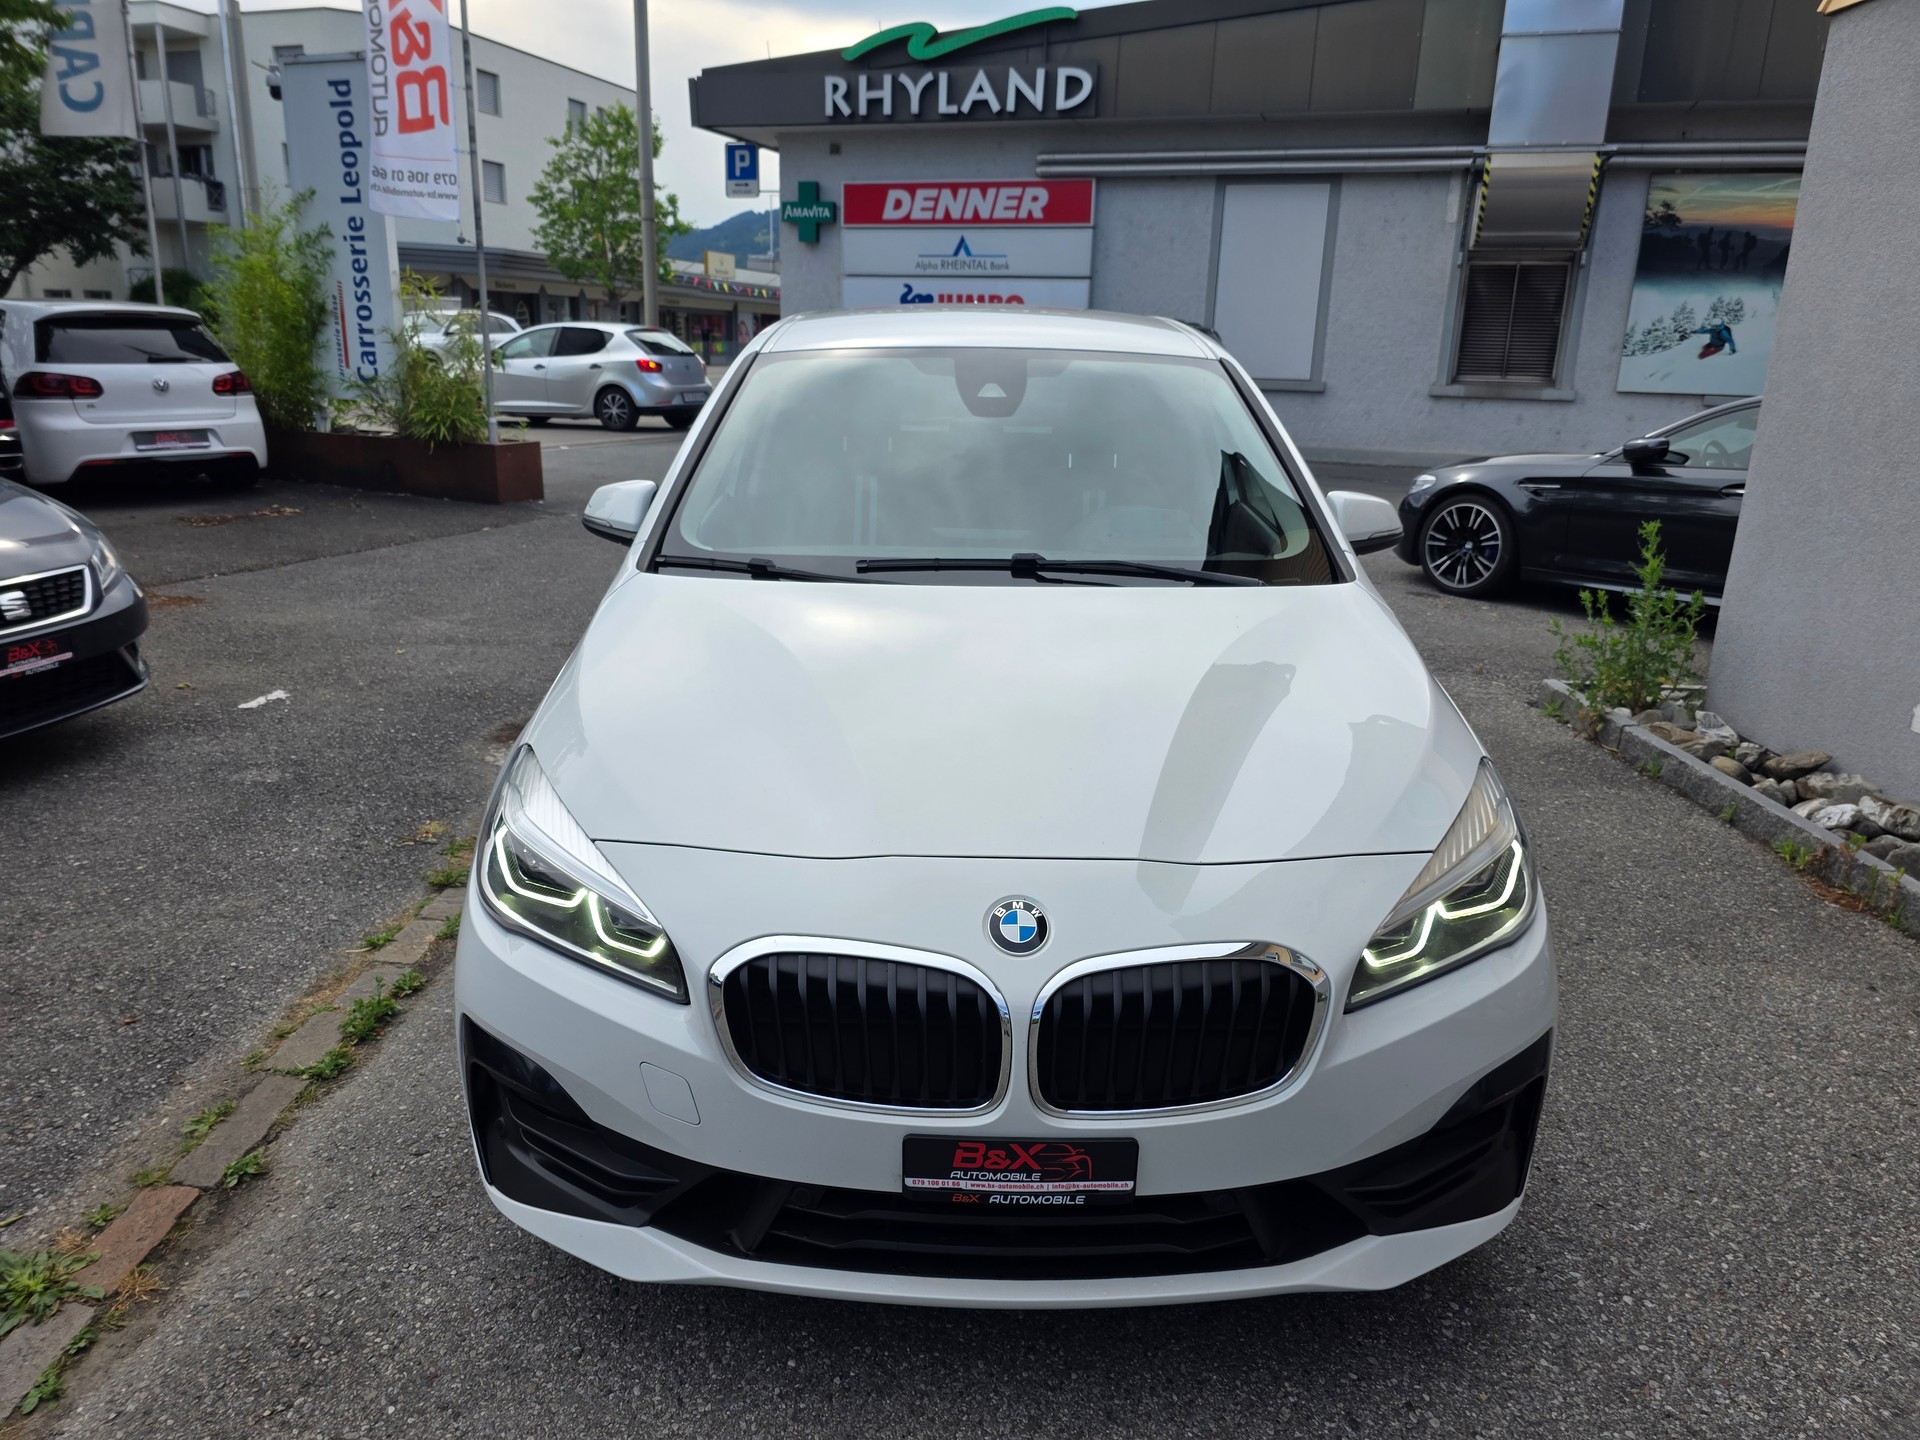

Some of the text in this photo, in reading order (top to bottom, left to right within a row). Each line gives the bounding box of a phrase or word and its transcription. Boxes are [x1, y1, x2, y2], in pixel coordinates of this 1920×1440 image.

[824, 66, 1094, 118] RHYLAND
[735, 150, 750, 177] P
[881, 186, 1049, 221] DENNER
[327, 79, 378, 384] Carrosserie Leopold
[915, 260, 1009, 271] Alpha RHEINTAL Bank
[994, 901, 1042, 917] BMW
[953, 1142, 1047, 1170] B&X
[950, 1170, 1042, 1181] AUTOMOBILE
[970, 1182, 1045, 1190] www.bx-automobile.ch
[952, 1193, 1086, 1205] B&X AUTOMOBILE
